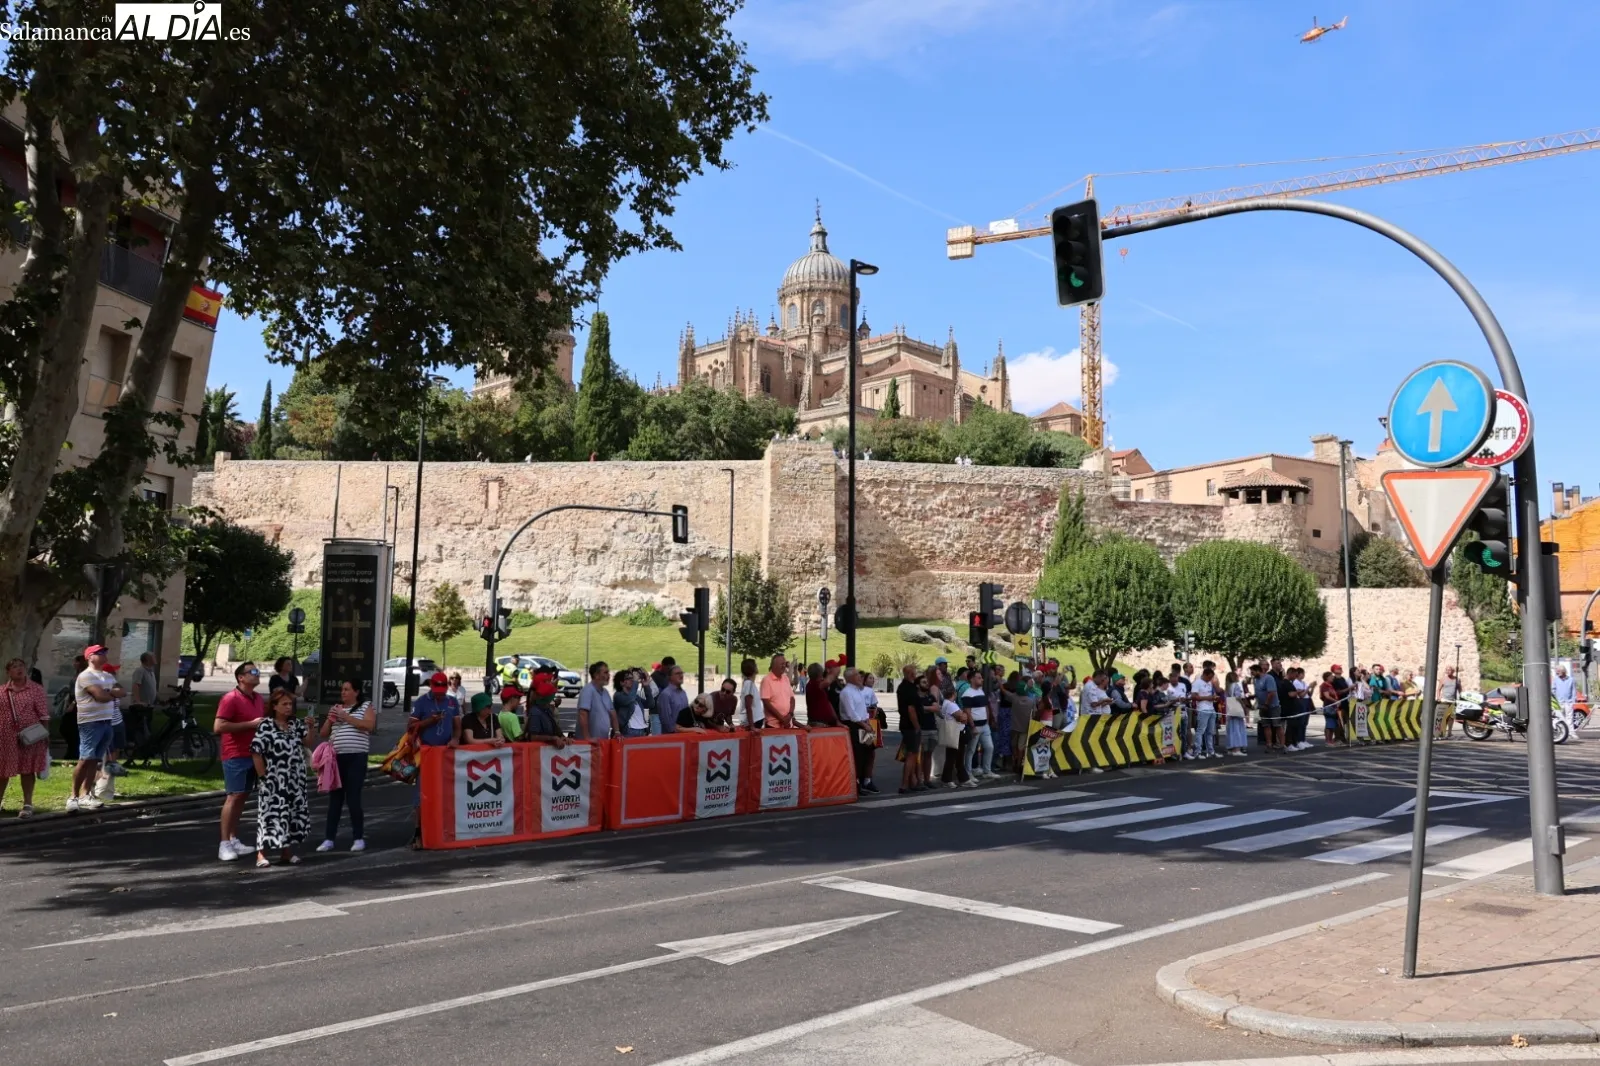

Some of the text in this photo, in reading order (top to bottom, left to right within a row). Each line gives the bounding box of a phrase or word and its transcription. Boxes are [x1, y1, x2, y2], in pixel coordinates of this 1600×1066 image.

[551, 794, 581, 804] WÜRTH
[704, 792, 729, 802] MODYF
[467, 800, 502, 811] WÜRTH
[551, 802, 581, 812] MODYF
[467, 808, 502, 820] MODYF
[467, 820, 503, 830] WORKWEAR
